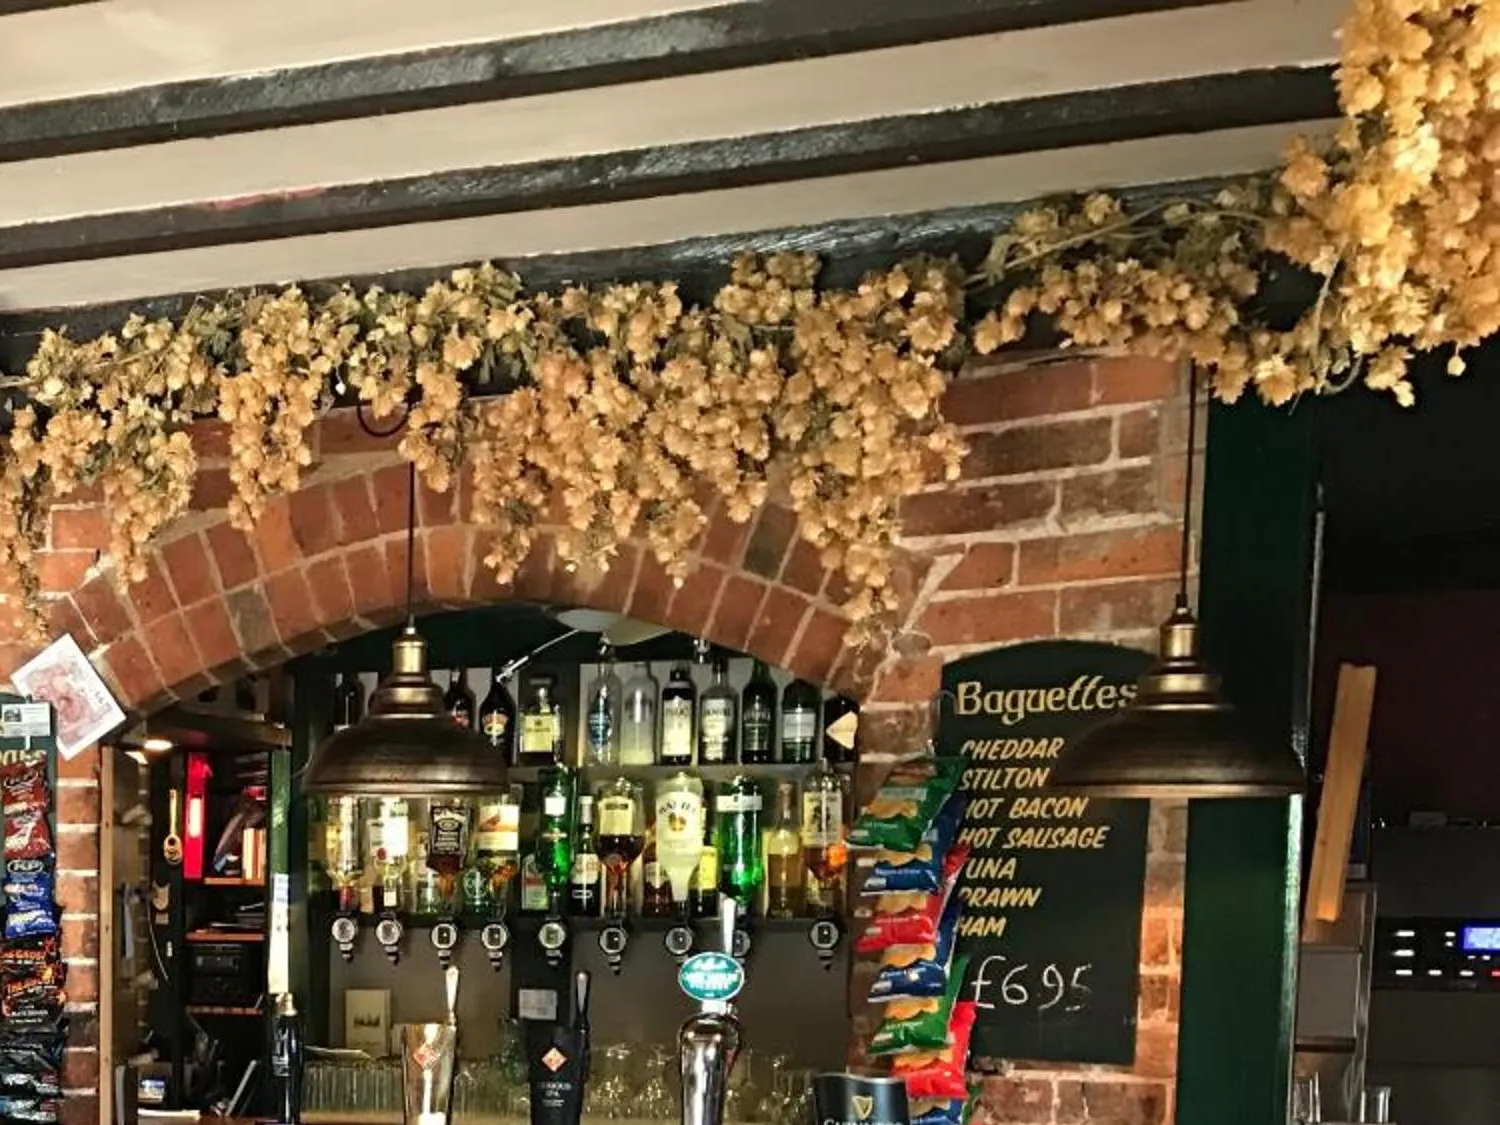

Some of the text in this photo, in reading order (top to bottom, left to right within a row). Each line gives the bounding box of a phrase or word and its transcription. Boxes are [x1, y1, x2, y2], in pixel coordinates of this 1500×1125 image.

[958, 767, 1050, 790] STILTON
[1009, 796, 1089, 819] BACON
[957, 825, 1111, 849] HOT SAUSAGE
[965, 857, 1017, 880] UNA
